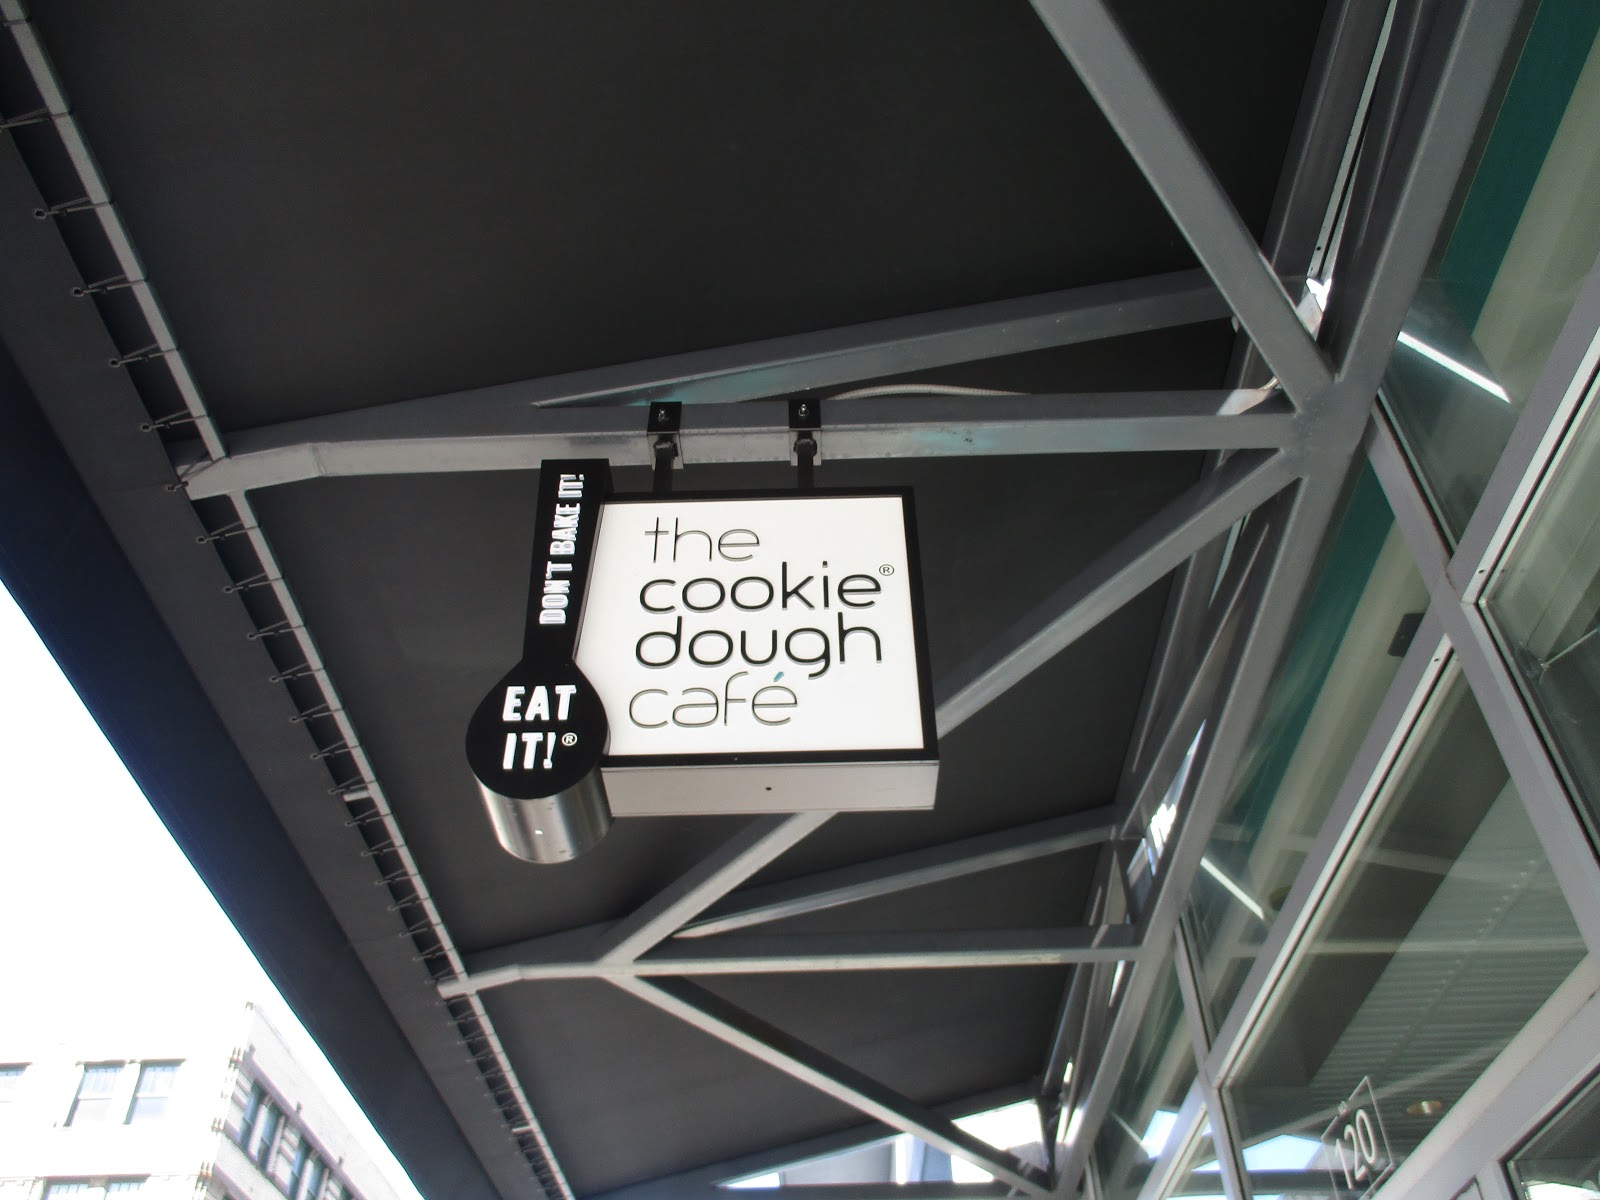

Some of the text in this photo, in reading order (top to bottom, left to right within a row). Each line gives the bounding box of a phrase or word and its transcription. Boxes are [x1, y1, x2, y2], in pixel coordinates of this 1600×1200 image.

[539, 474, 585, 624] DON'T BAKE IT!
[644, 517, 760, 563] the
[635, 612, 882, 680] dough
[502, 684, 577, 721] EAT
[629, 671, 798, 729] café
[1335, 1108, 1377, 1190] 120
